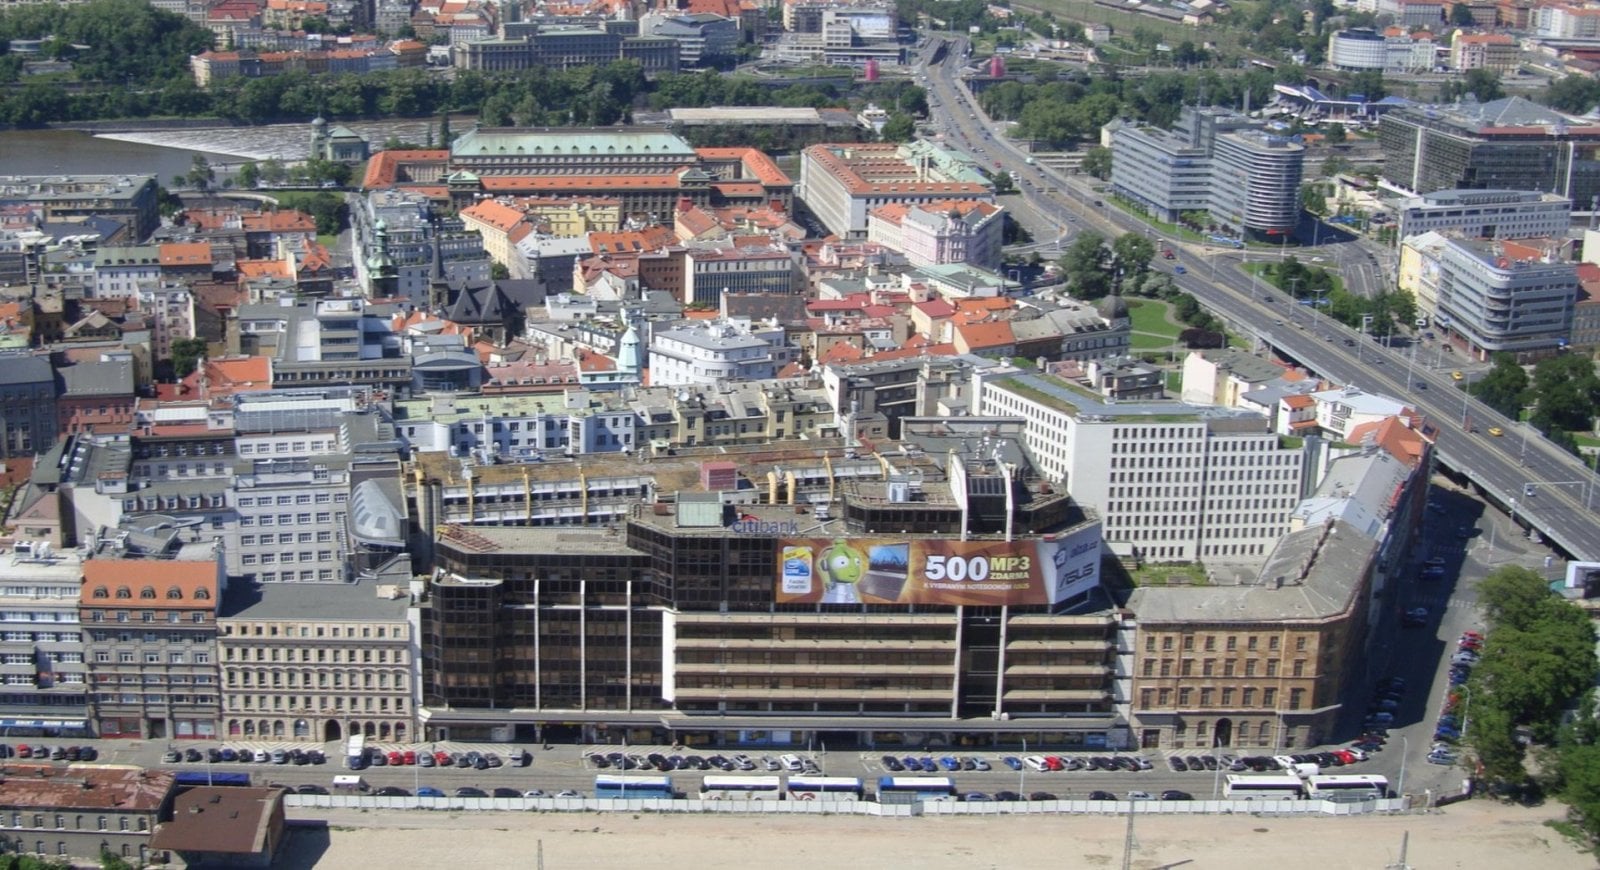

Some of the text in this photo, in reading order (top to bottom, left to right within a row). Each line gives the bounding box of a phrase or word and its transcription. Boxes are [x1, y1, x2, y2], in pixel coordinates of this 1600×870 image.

[732, 518, 798, 534] citibank
[925, 555, 1030, 581] 500 MP3
[989, 572, 1030, 580] ZDARMA
[1059, 563, 1094, 588] ASUS
